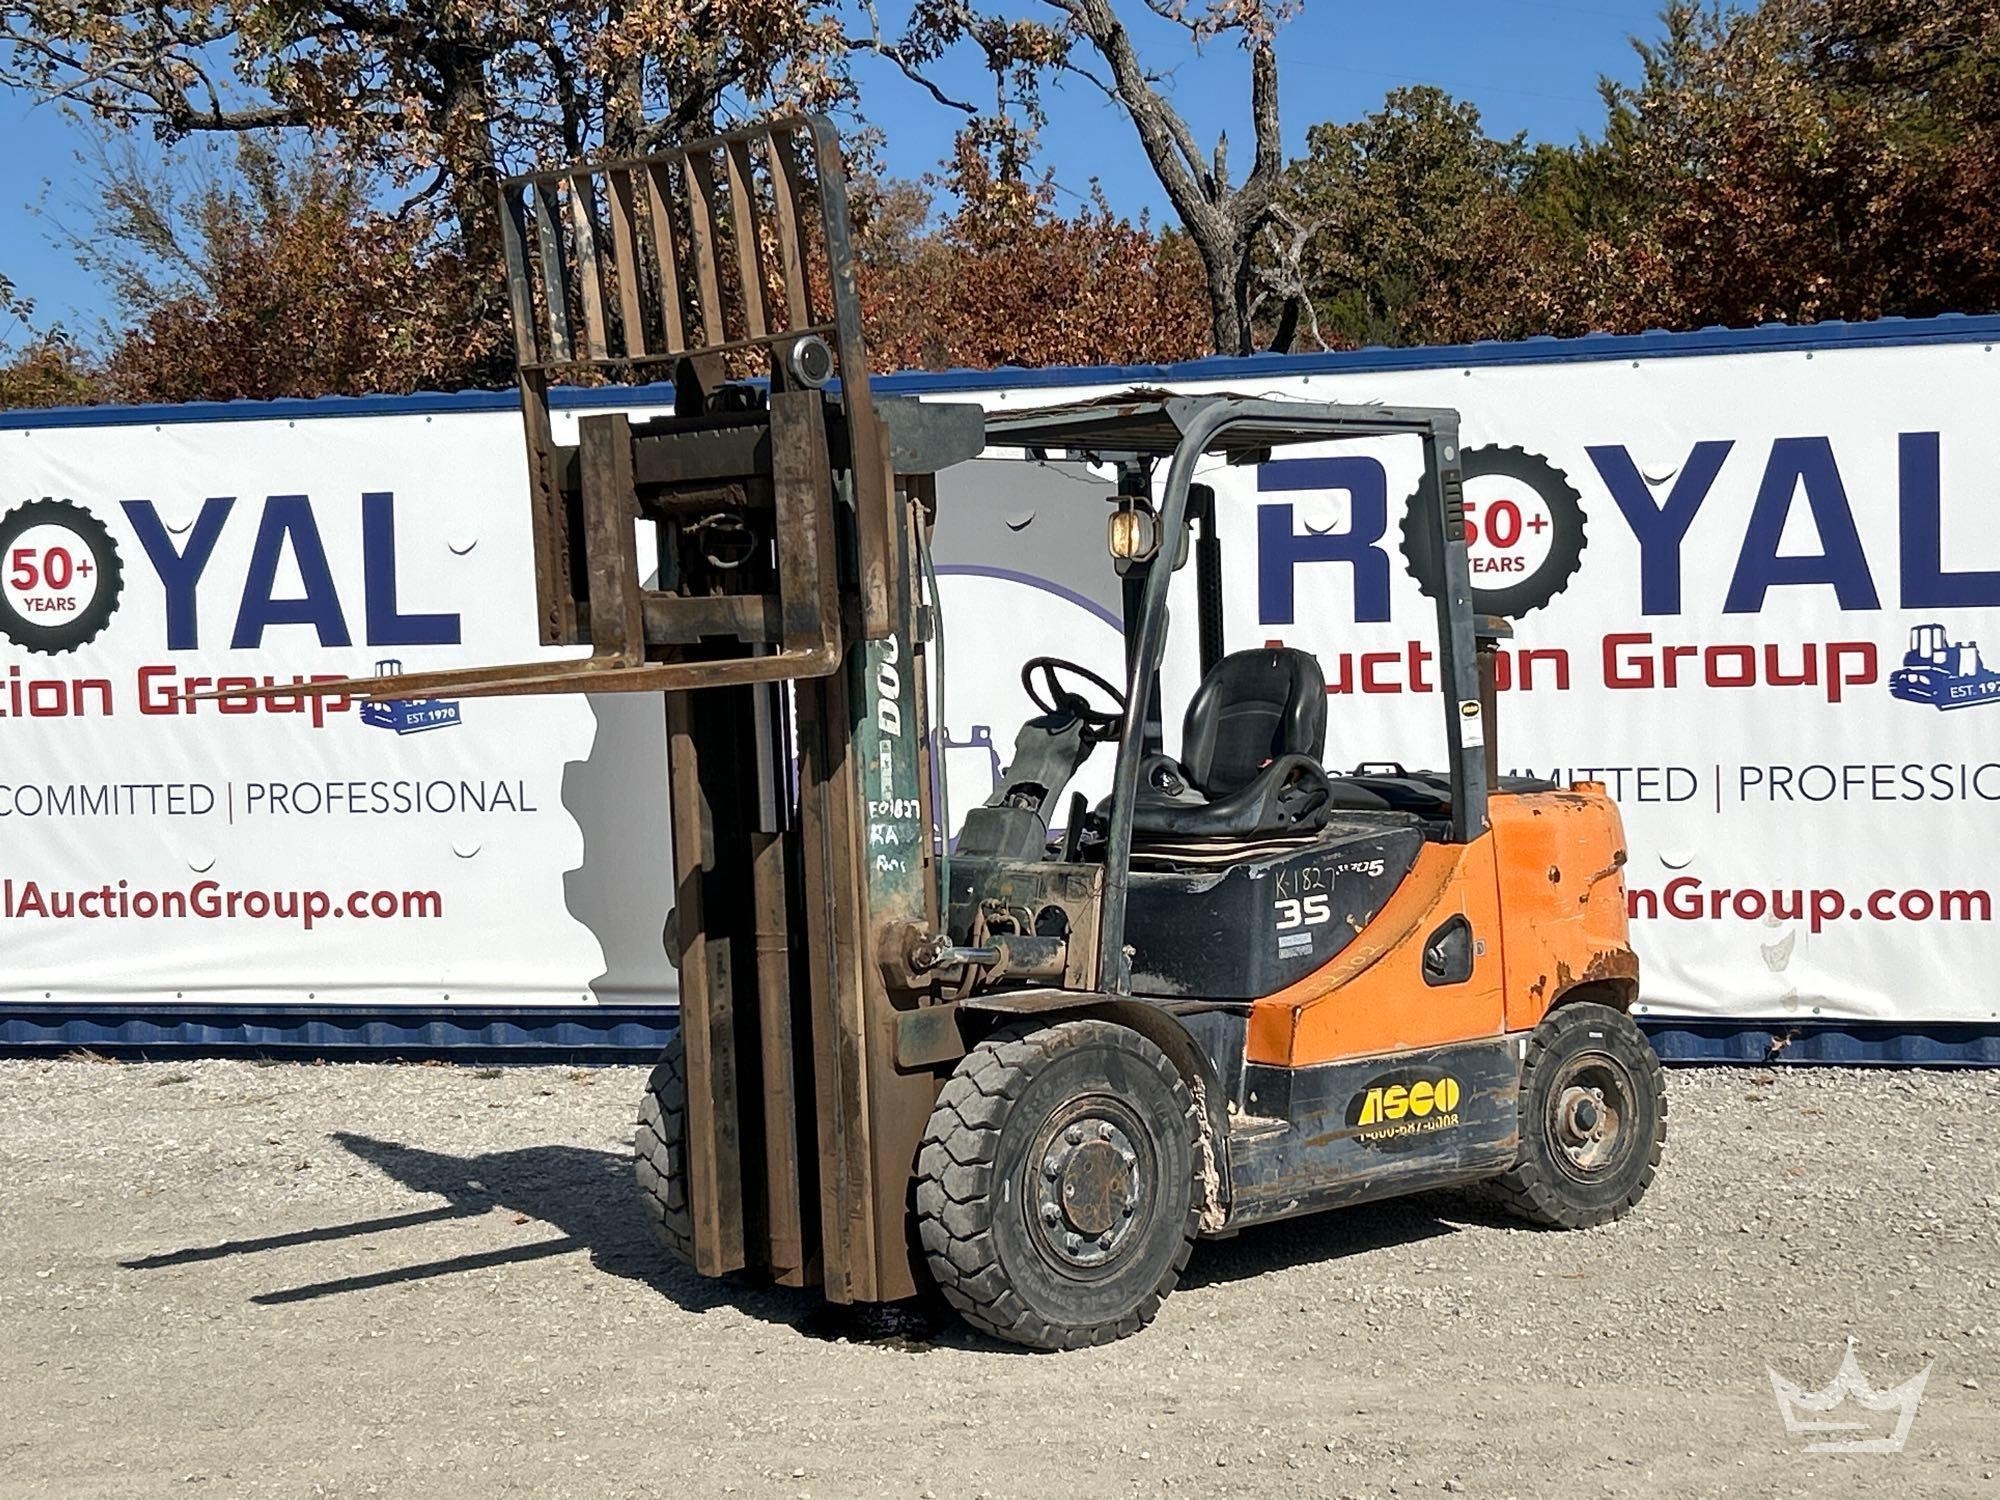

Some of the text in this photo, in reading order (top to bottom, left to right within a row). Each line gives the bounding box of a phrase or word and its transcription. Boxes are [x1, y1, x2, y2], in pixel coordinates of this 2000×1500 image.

[11, 547, 94, 591] 50+
[1468, 557, 1525, 573] EARS
[23, 597, 77, 612] YEARS
[1603, 632, 1879, 703] Group
[138, 665, 351, 728] Group
[1950, 684, 1977, 698] EST.
[406, 708, 456, 724] EST. 1970
[246, 779, 537, 815] PROFESSIONAL
[1274, 893, 1331, 930] 35
[1357, 1077, 1460, 1127] ASCO
